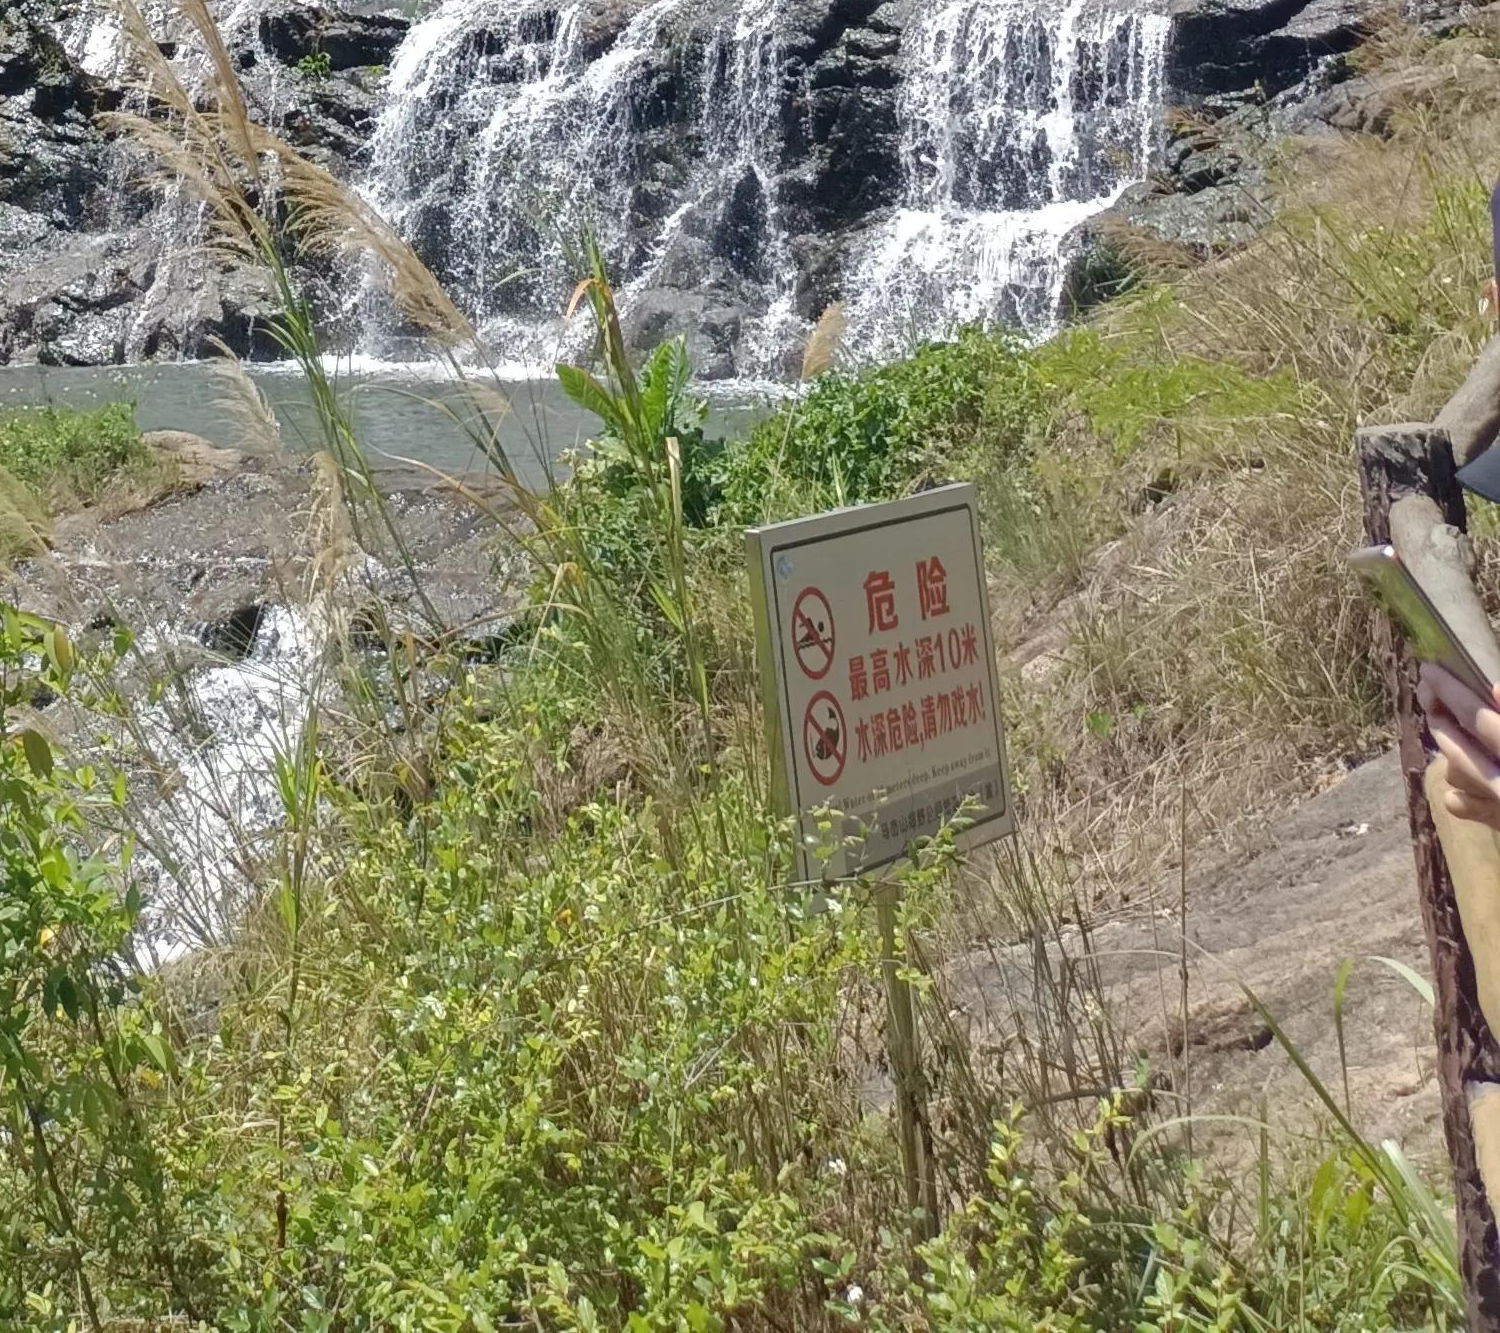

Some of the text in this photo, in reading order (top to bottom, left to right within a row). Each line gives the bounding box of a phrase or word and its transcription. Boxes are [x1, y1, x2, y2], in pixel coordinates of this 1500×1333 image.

[863, 555, 950, 636] 危险
[848, 622, 980, 702] 最高水深10米
[931, 762, 949, 777] Keep
